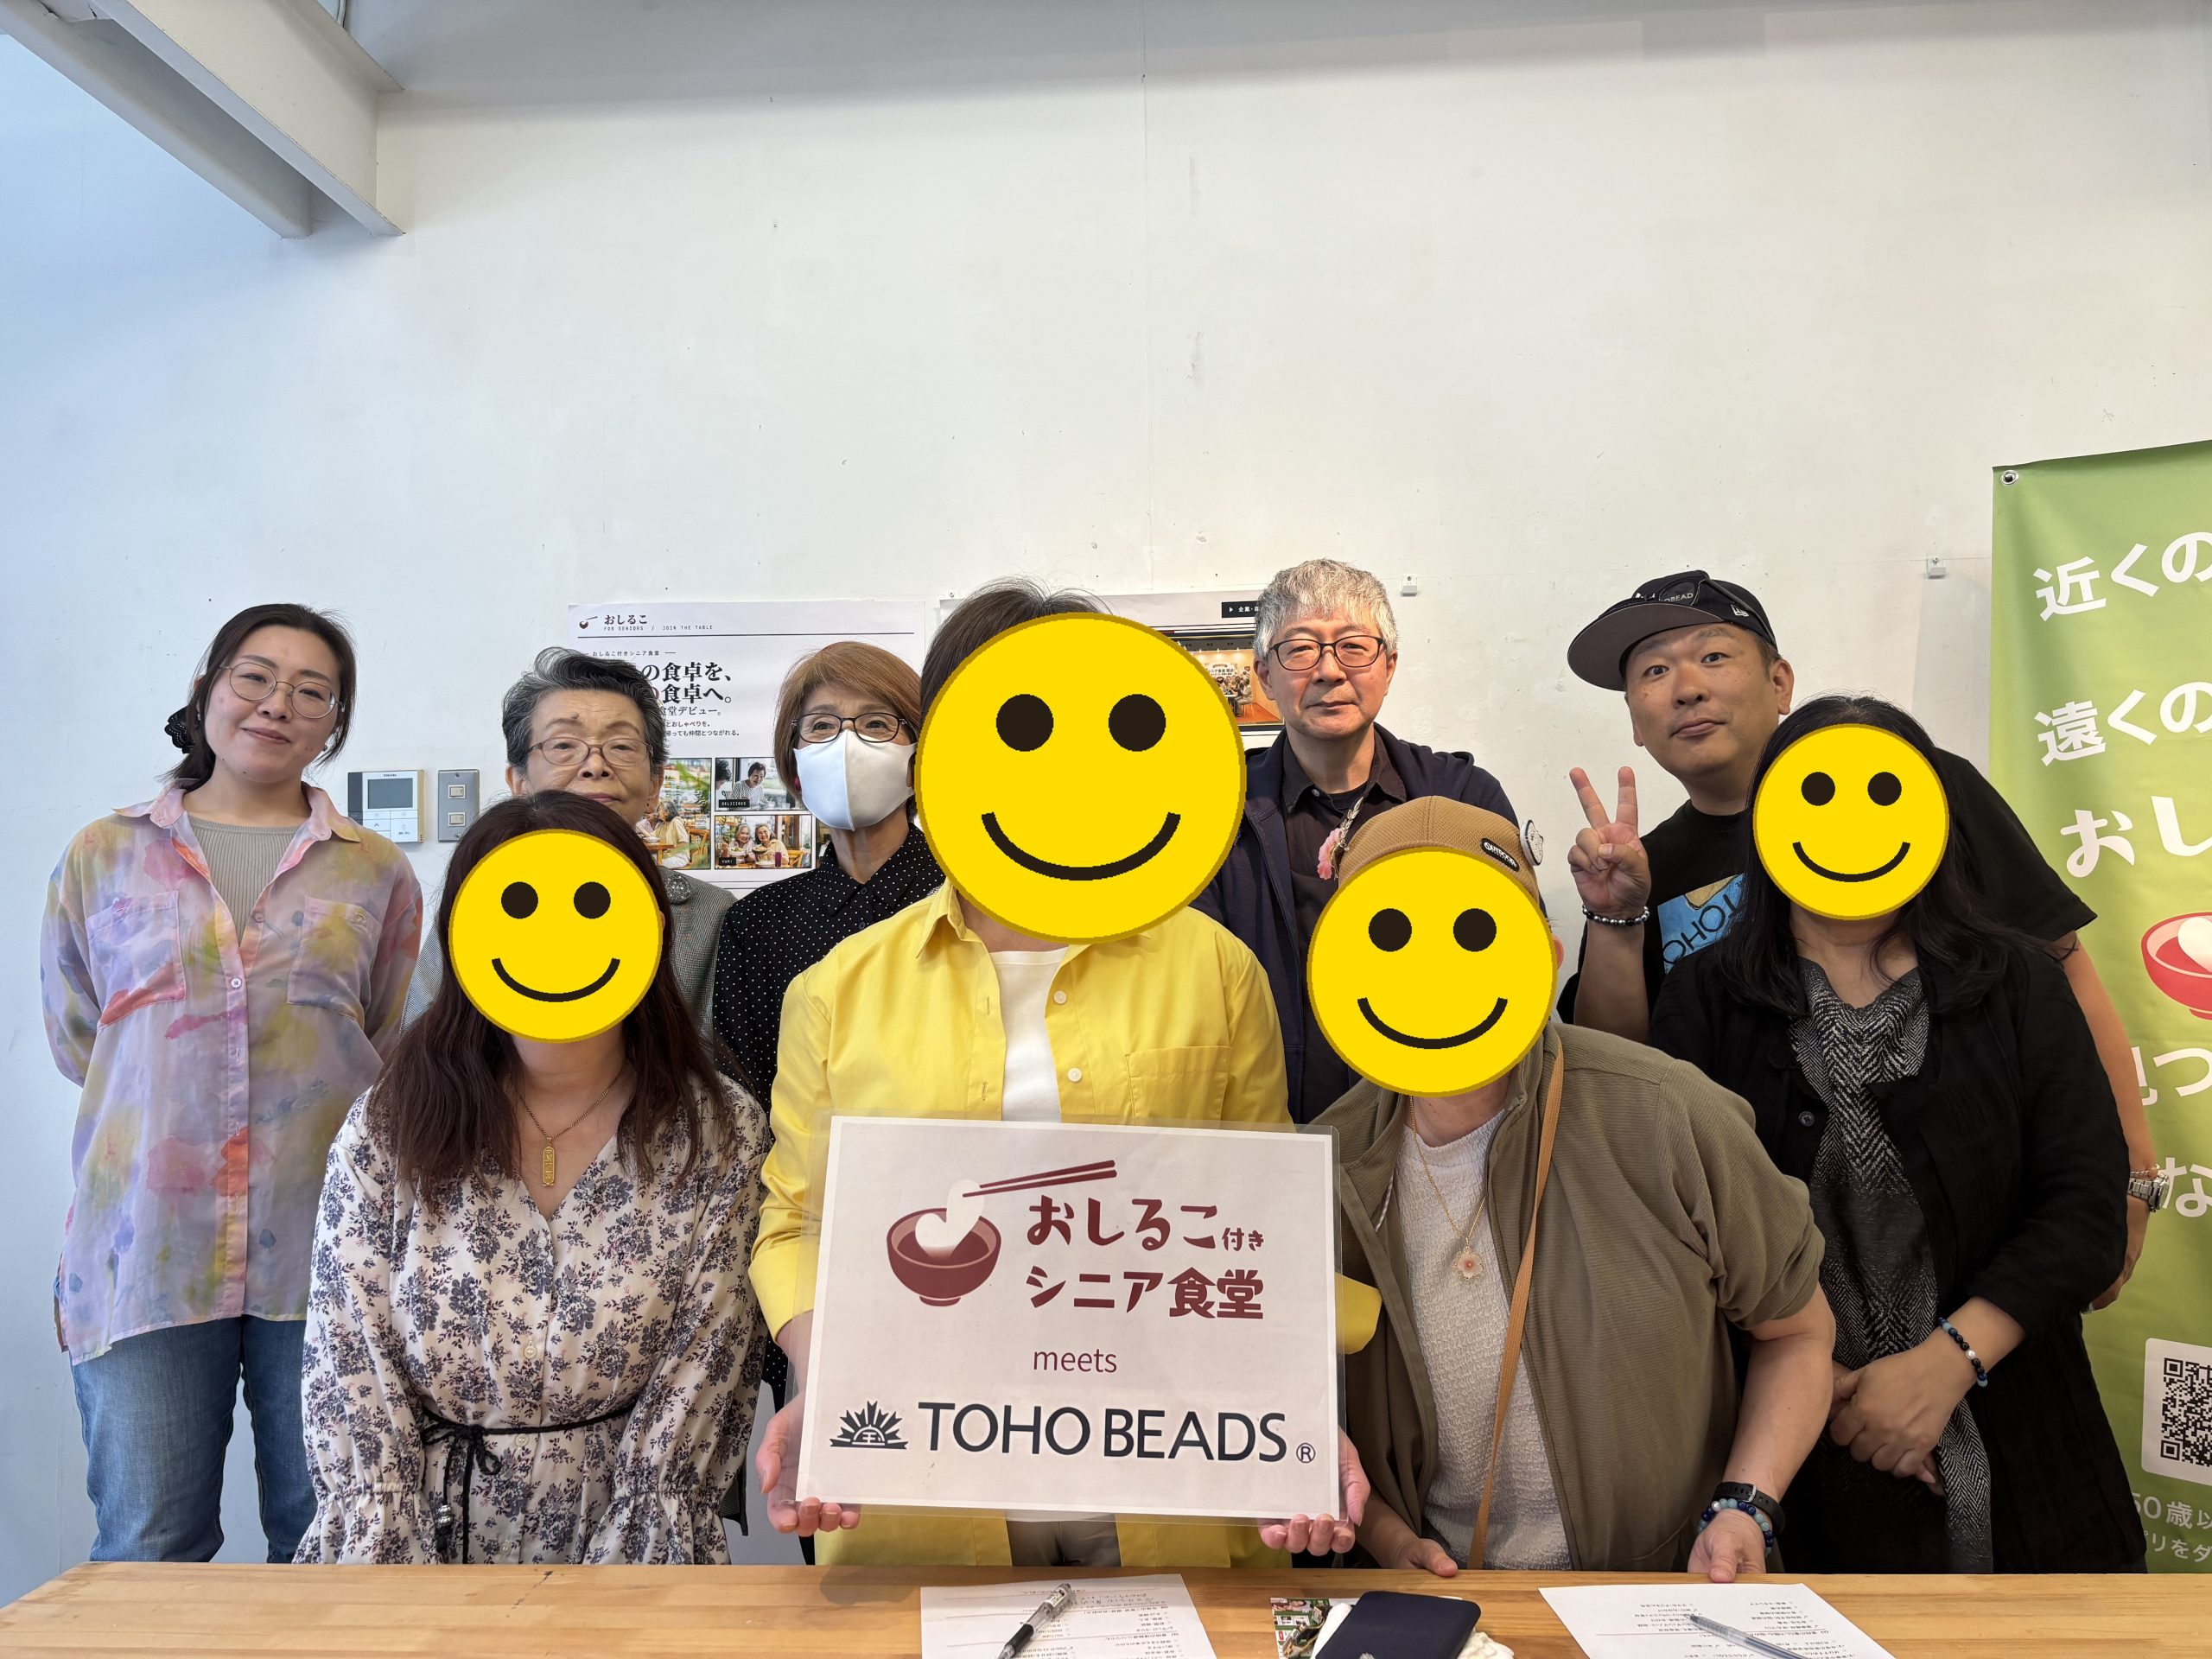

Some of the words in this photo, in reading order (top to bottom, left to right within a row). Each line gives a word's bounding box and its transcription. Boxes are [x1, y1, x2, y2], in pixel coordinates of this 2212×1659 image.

[1661, 593, 1694, 602] OBEAD
[2033, 531, 2212, 621] 近くの
[604, 614, 648, 626] おしるこ
[2034, 681, 2212, 766] 遠くの
[2060, 795, 2212, 878] おし
[2131, 1046, 2212, 1106] つ
[1027, 1194, 1264, 1252] おしるこ付き
[1026, 1265, 1264, 1319] シニア食堂
[1033, 1349, 1117, 1374] meets
[918, 1402, 1091, 1456] TOHO
[1103, 1408, 1287, 1463] BEADS
[2143, 1529, 2212, 1562] リをダ
